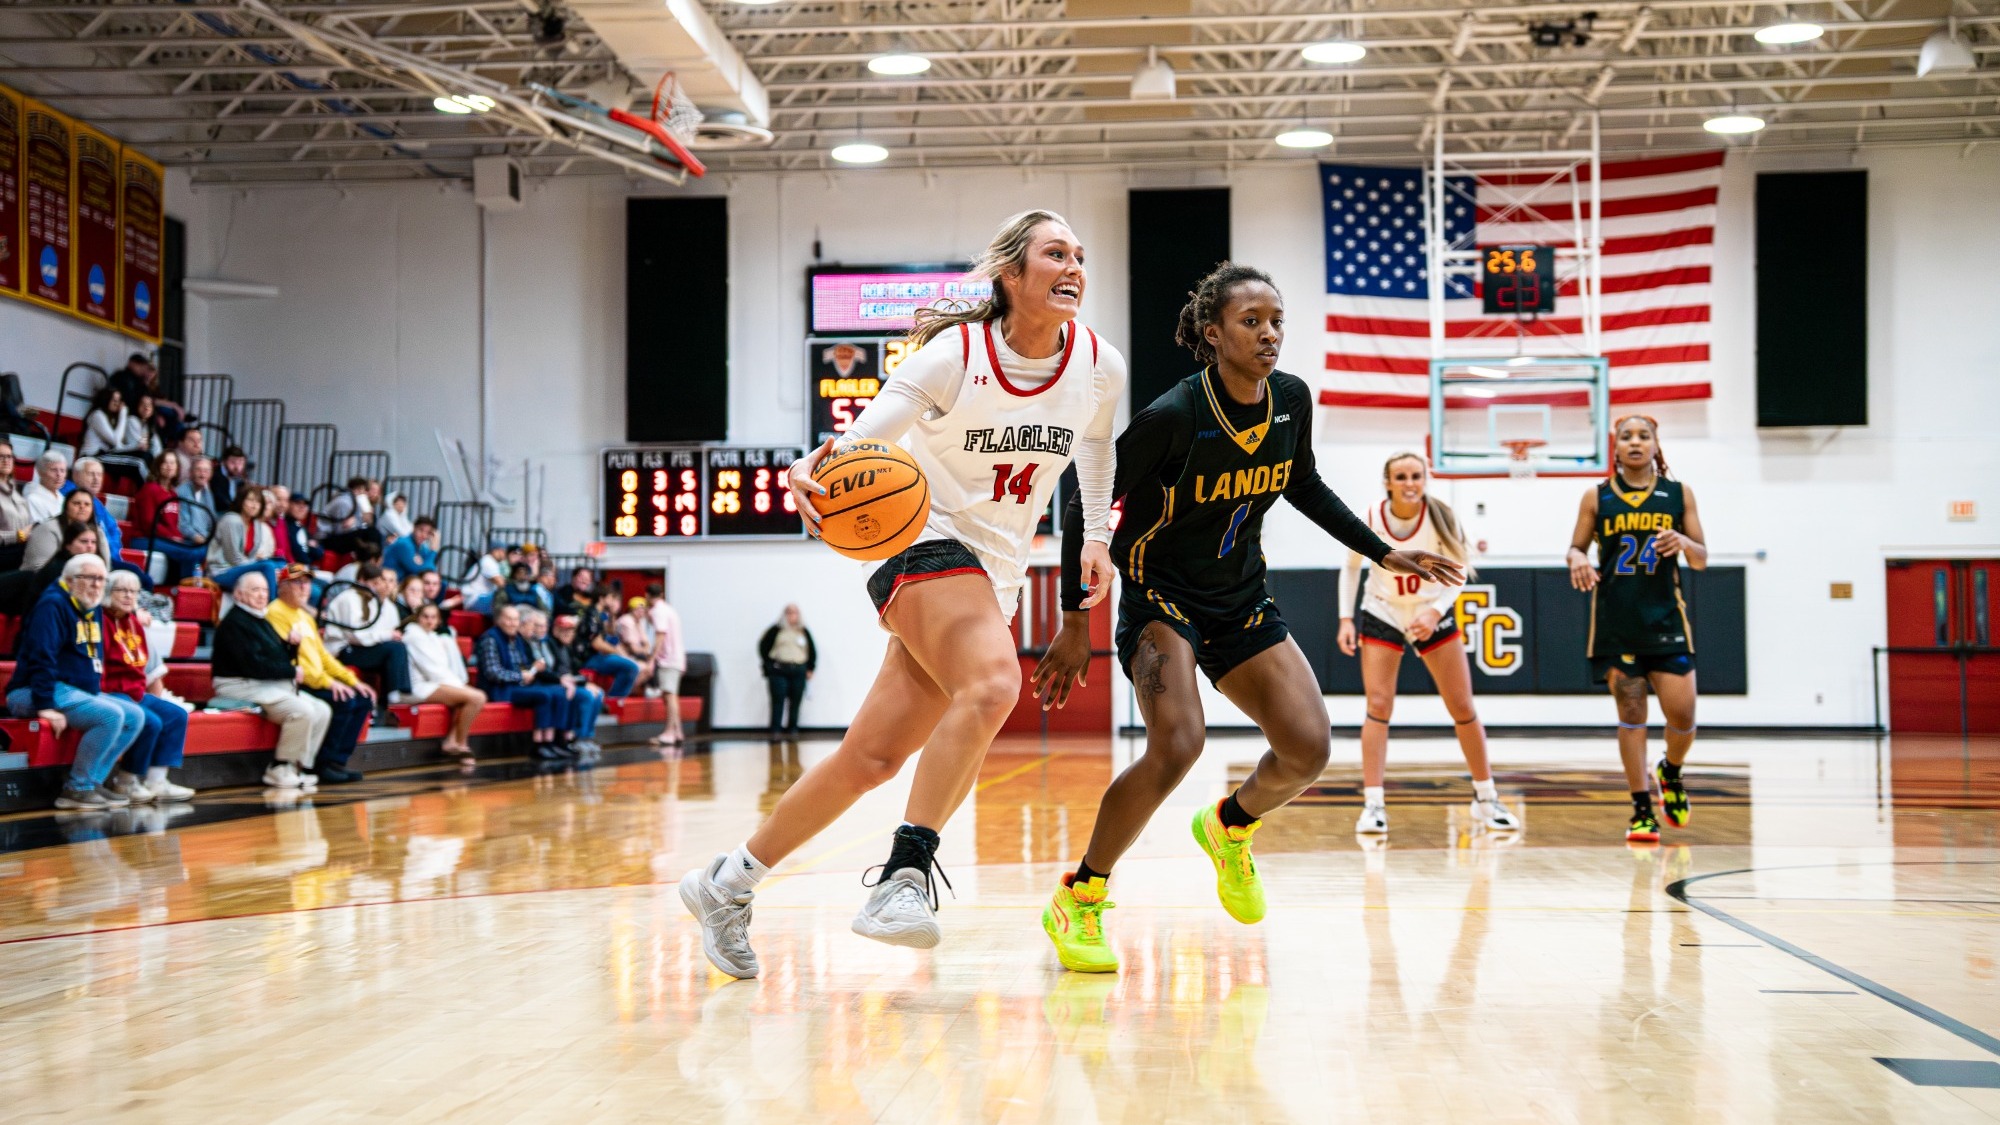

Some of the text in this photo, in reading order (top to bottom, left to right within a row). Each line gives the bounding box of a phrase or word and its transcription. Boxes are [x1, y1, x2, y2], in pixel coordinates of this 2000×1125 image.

[820, 378, 879, 397] FLAGLER
[1274, 413, 1290, 424] NCAA
[964, 425, 1073, 457] FLAGLER
[642, 452, 664, 468] FLS
[671, 452, 693, 468] PTS
[745, 451, 767, 467] FLS
[621, 470, 696, 492] 0 3 5
[755, 469, 770, 490] 2
[829, 470, 876, 499] EVO
[990, 463, 1040, 504] 14
[1195, 459, 1293, 503] LANDER
[621, 492, 638, 515] 2
[652, 494, 668, 512] 4
[712, 491, 740, 514] 25
[755, 491, 770, 512] 0
[615, 514, 696, 537] 10 3 0
[1217, 501, 1253, 558] 1
[1604, 512, 1673, 536] LANDER
[1615, 535, 1659, 575] 24
[1394, 575, 1421, 595] 10
